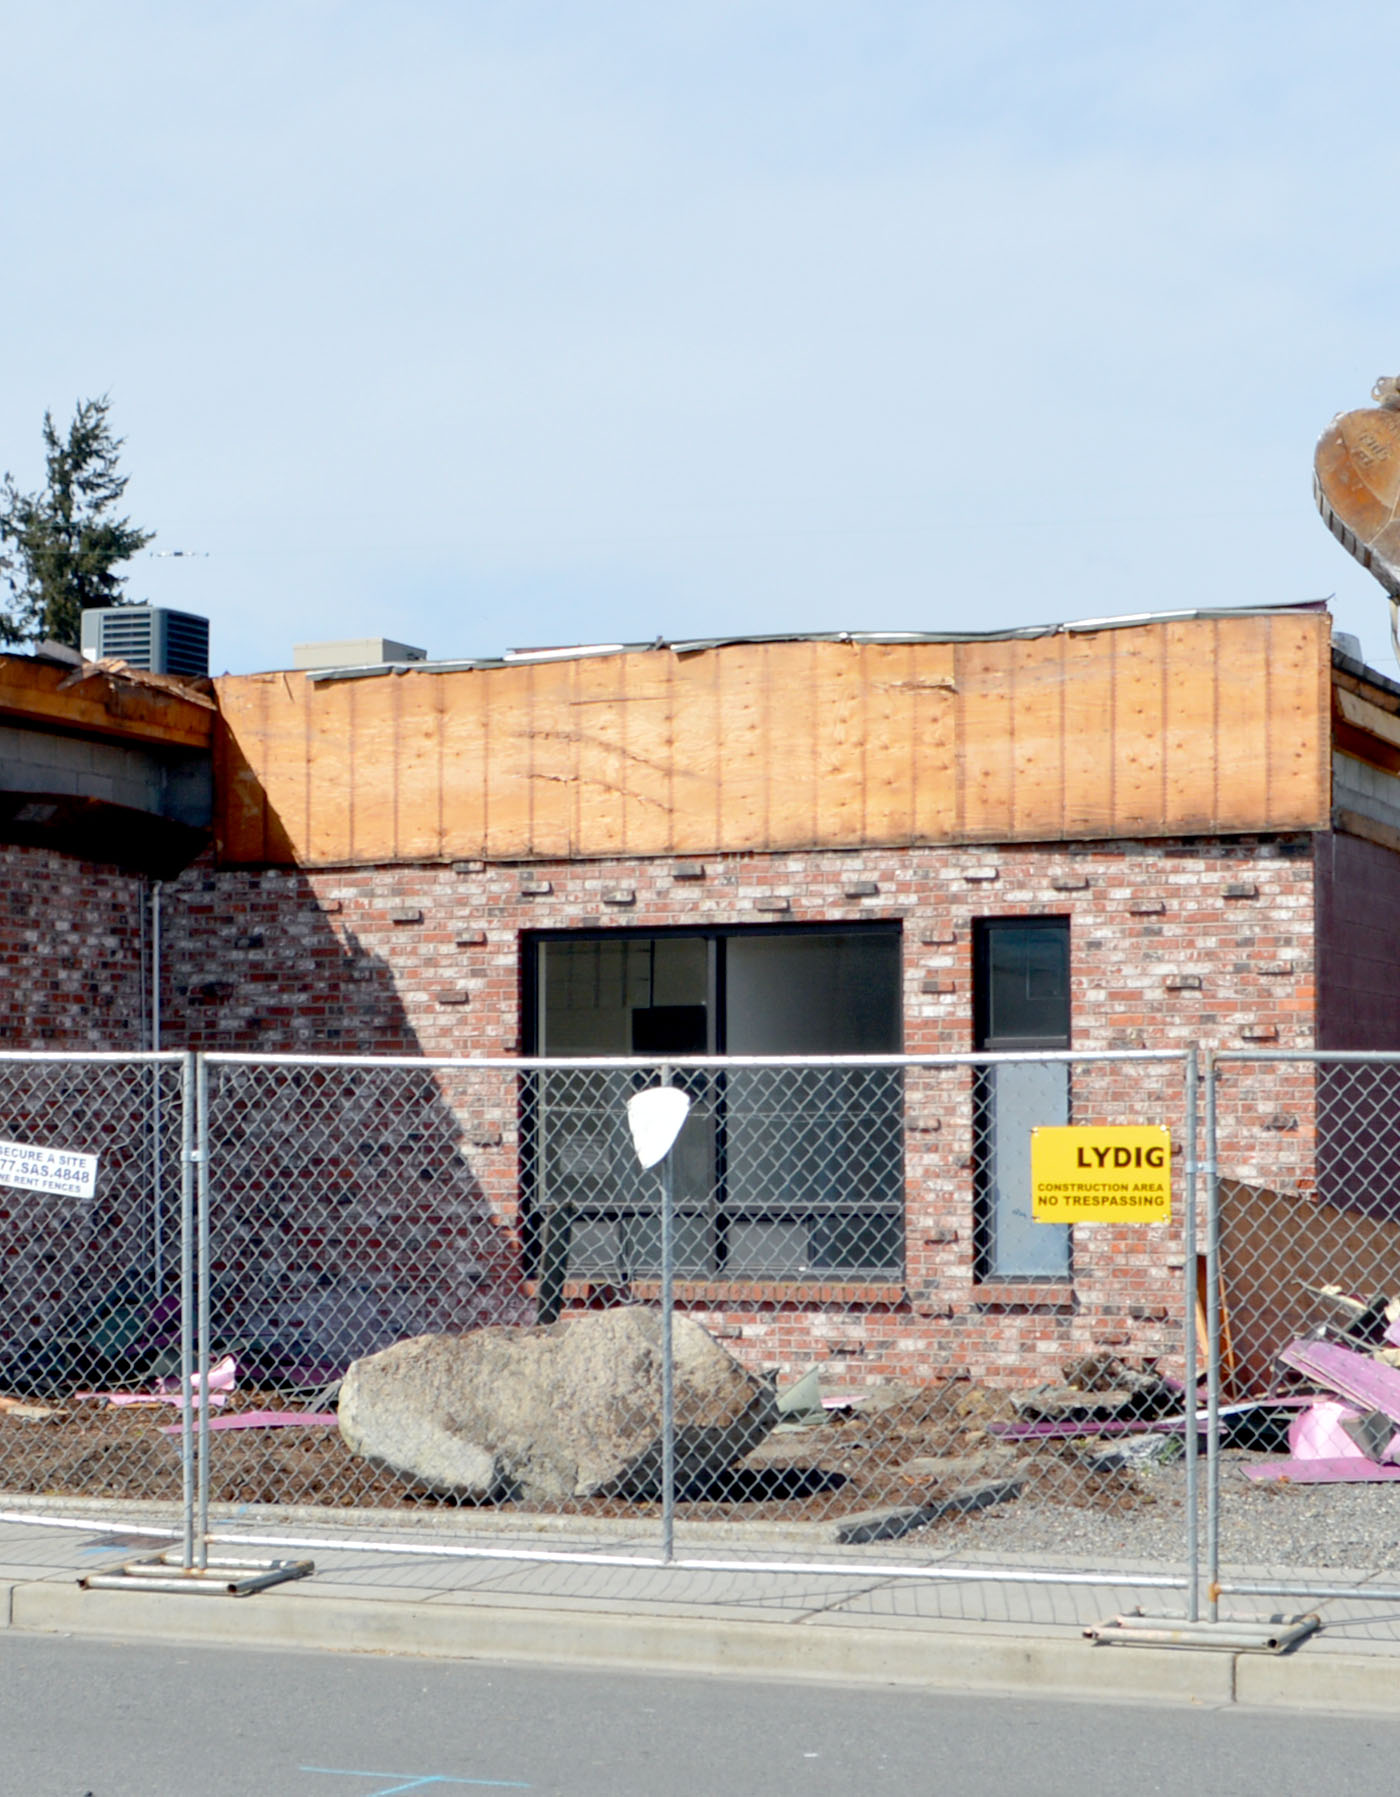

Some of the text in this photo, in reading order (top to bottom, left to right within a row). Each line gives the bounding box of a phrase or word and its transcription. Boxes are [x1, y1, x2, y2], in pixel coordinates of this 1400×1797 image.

[47, 1153, 55, 1163] A
[59, 1155, 87, 1168] SITE
[1077, 1146, 1165, 1168] LYDIG
[13, 1175, 39, 1186] RENT
[42, 1180, 81, 1193] FENCES
[1037, 1183, 1165, 1192] CONSTRUCTION AREA
[1037, 1195, 1165, 1207] NO TRESPASSING
